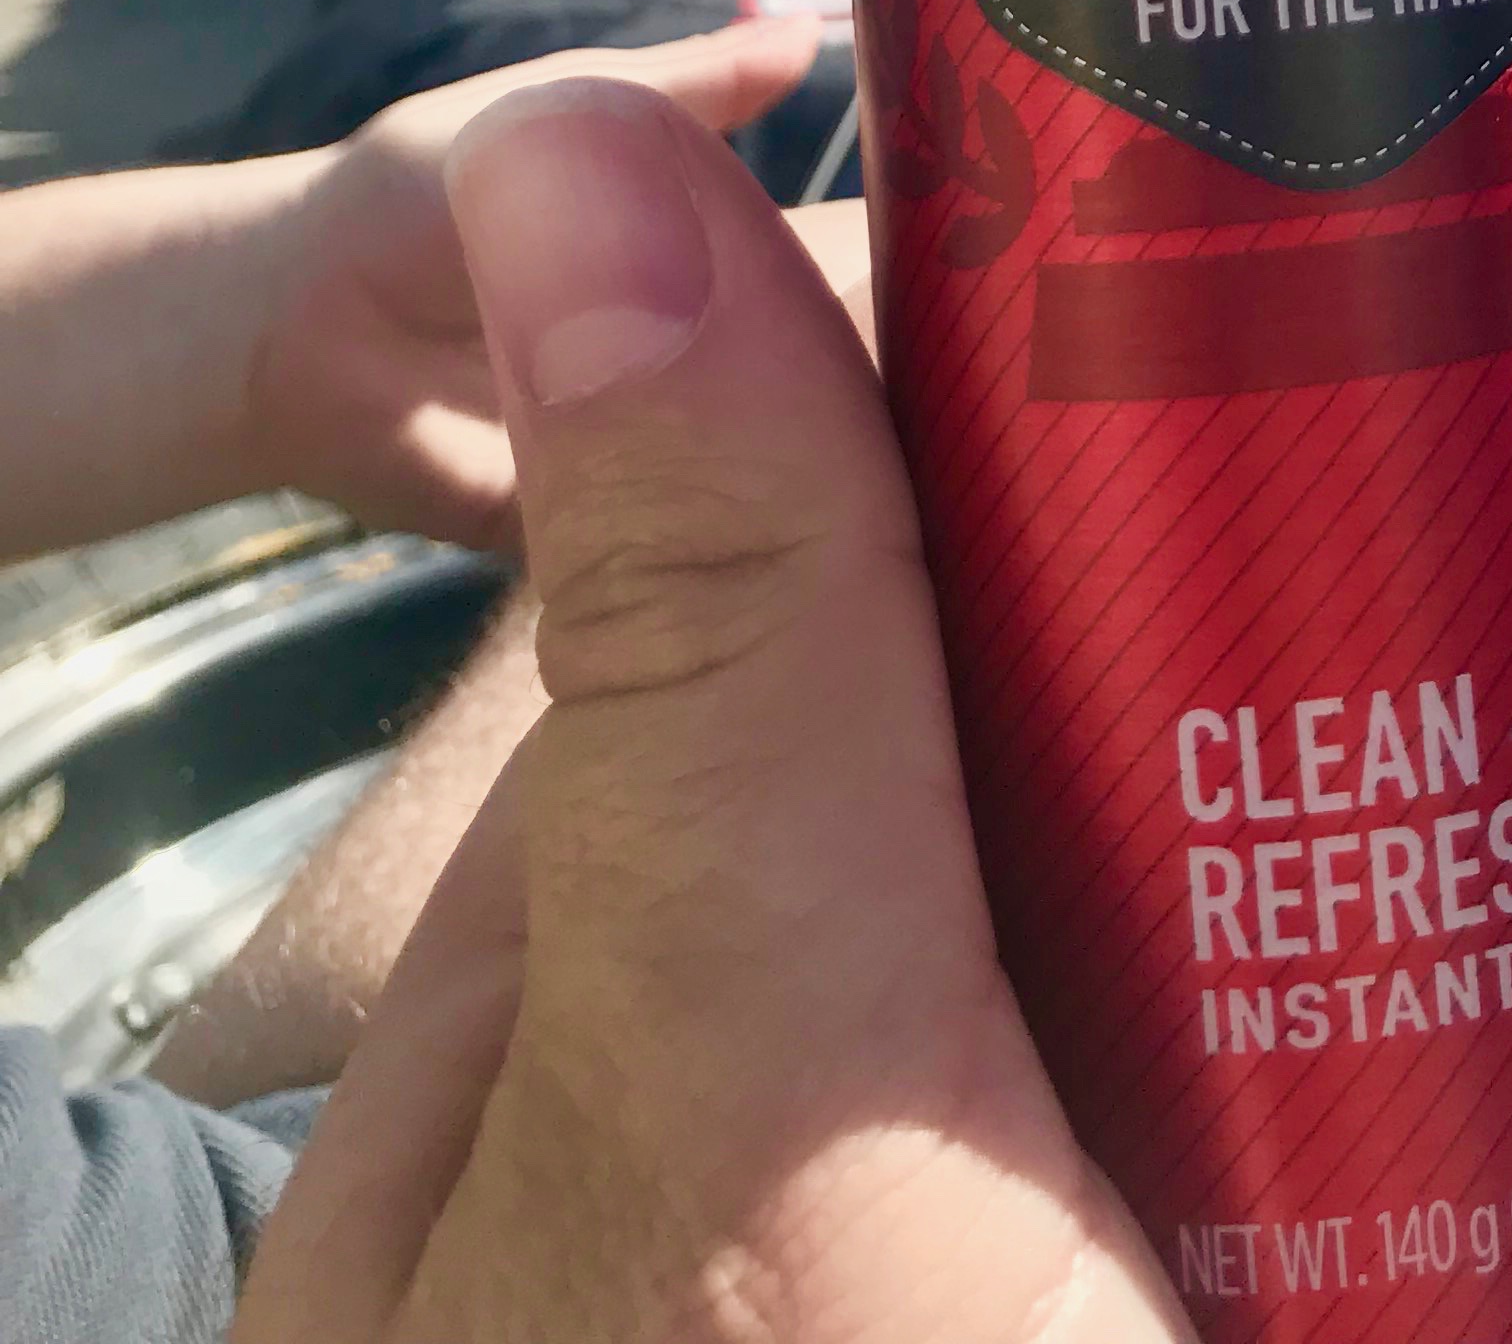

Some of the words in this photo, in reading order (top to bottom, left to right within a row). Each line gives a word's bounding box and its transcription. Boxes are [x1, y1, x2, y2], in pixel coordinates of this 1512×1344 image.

[1177, 673, 1481, 823] CLEAN
[1178, 1223, 1261, 1296] NET
[1275, 1216, 1368, 1293] WT.
[1376, 1200, 1458, 1282] 140
[1470, 1202, 1500, 1273] g
